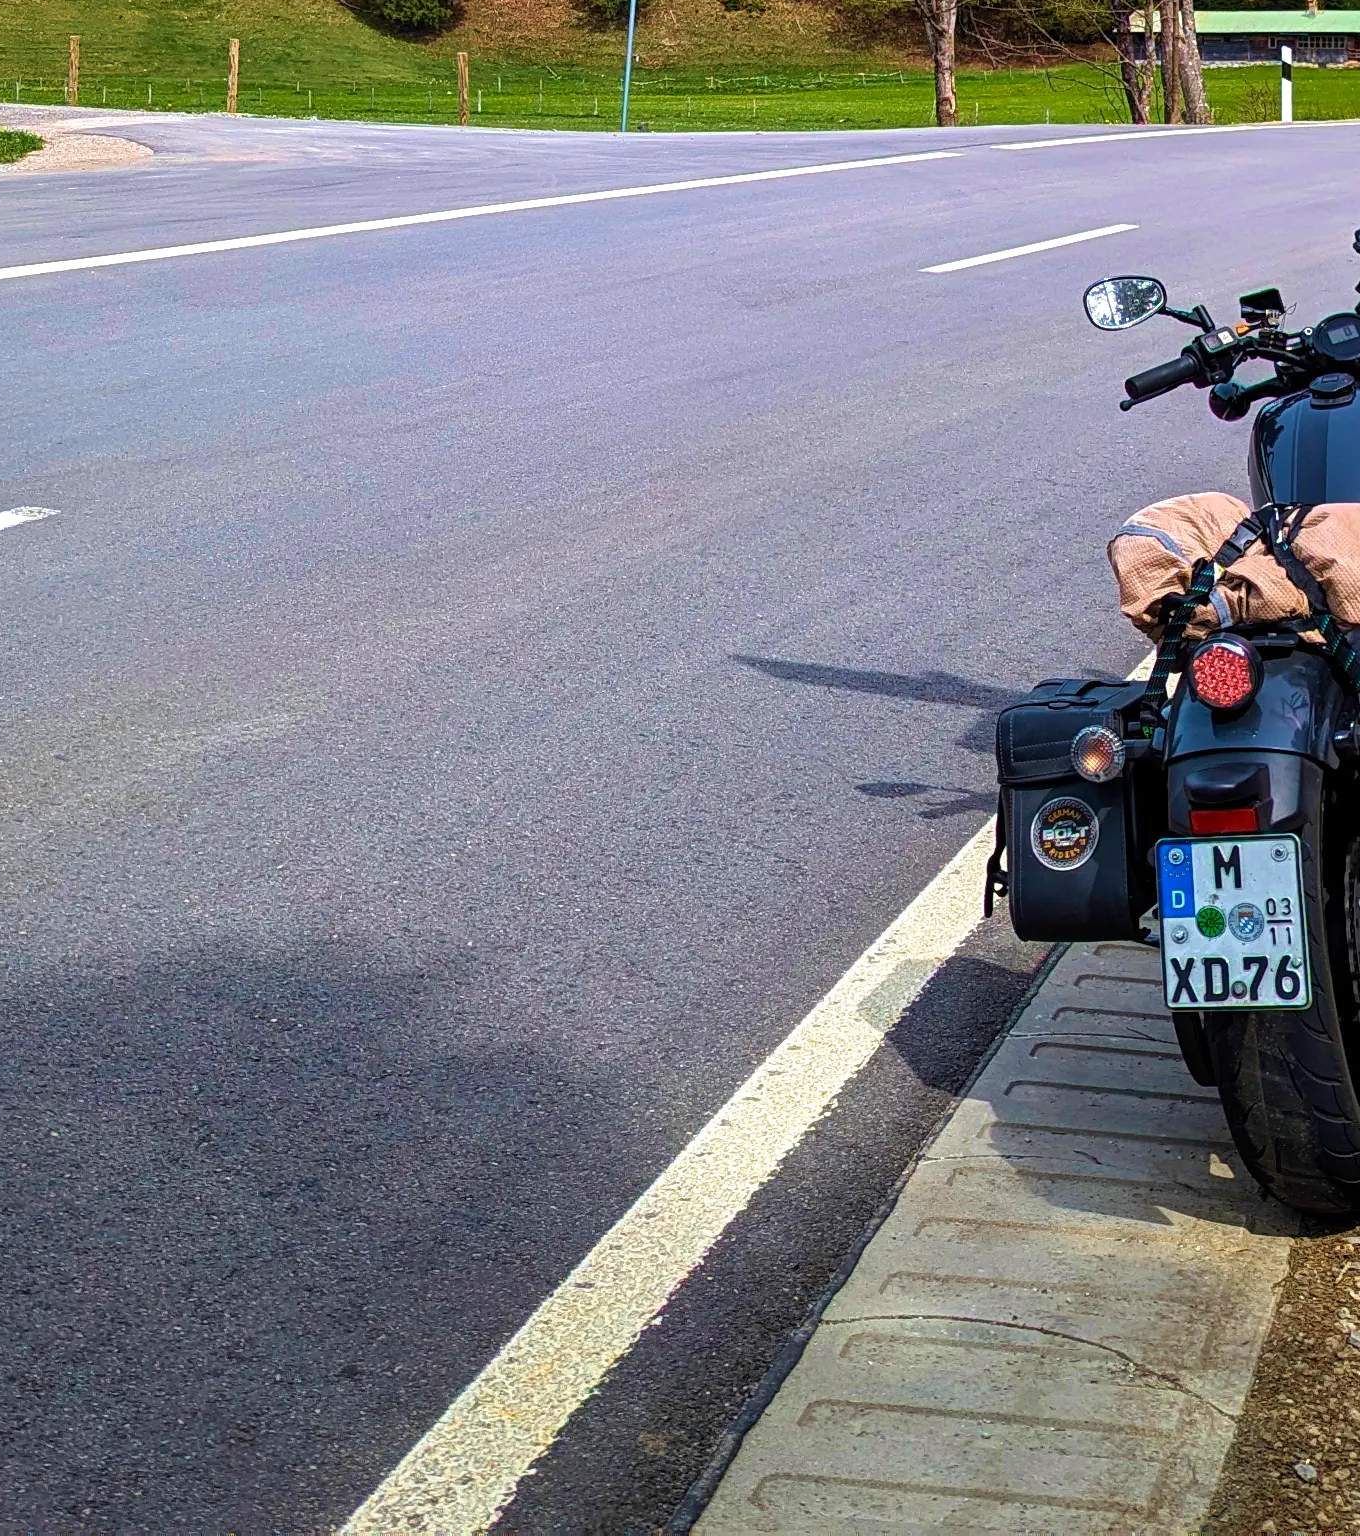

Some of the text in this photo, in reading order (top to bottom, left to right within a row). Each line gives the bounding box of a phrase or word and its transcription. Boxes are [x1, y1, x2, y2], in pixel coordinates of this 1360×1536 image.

[1042, 826, 1089, 840] BOLT
[1213, 845, 1242, 889] M
[1171, 890, 1185, 909] D
[1266, 897, 1291, 916] 03
[1270, 926, 1292, 946] 11
